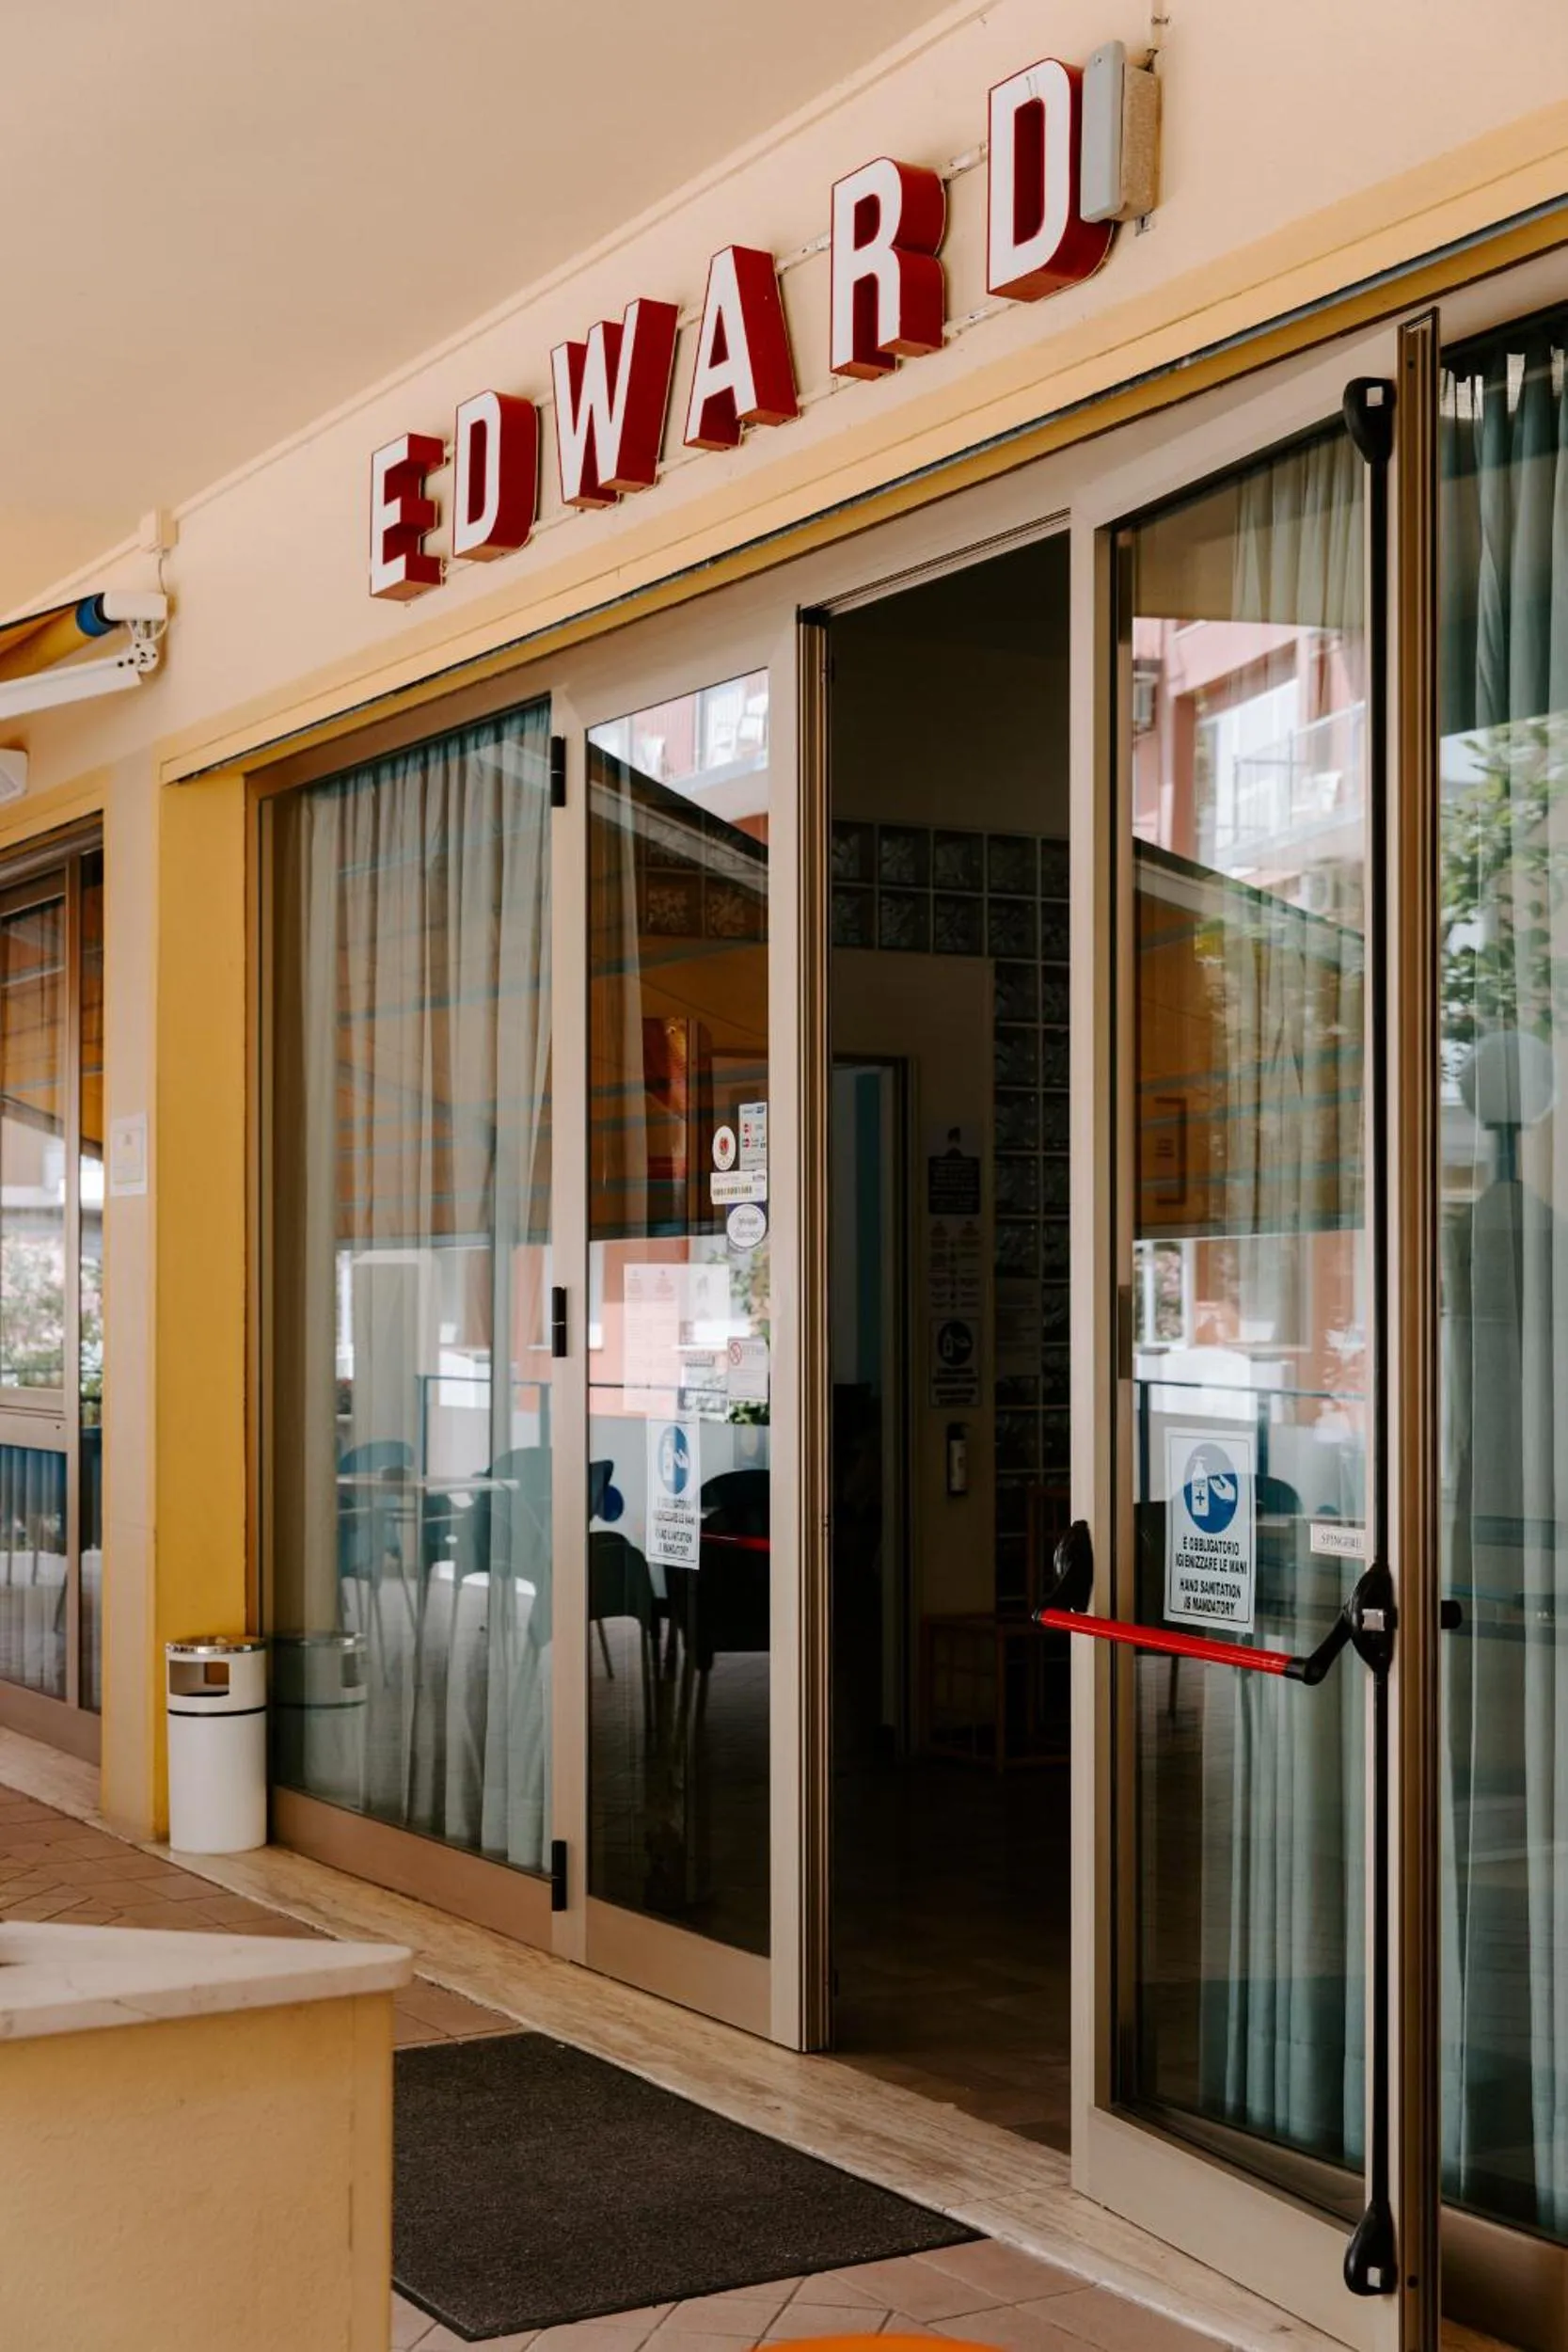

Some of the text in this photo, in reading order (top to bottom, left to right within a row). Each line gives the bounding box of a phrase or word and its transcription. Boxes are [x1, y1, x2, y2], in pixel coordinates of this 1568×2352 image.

[370, 57, 1113, 602] EDWARD
[1189, 1536, 1240, 1556] OBBLIGATORIO
[1175, 1552, 1248, 1575] IGIENIZZARE LE MANI
[1179, 1578, 1242, 1599] HAND SANITATION
[1183, 1596, 1236, 1616] IS MANDATORY
